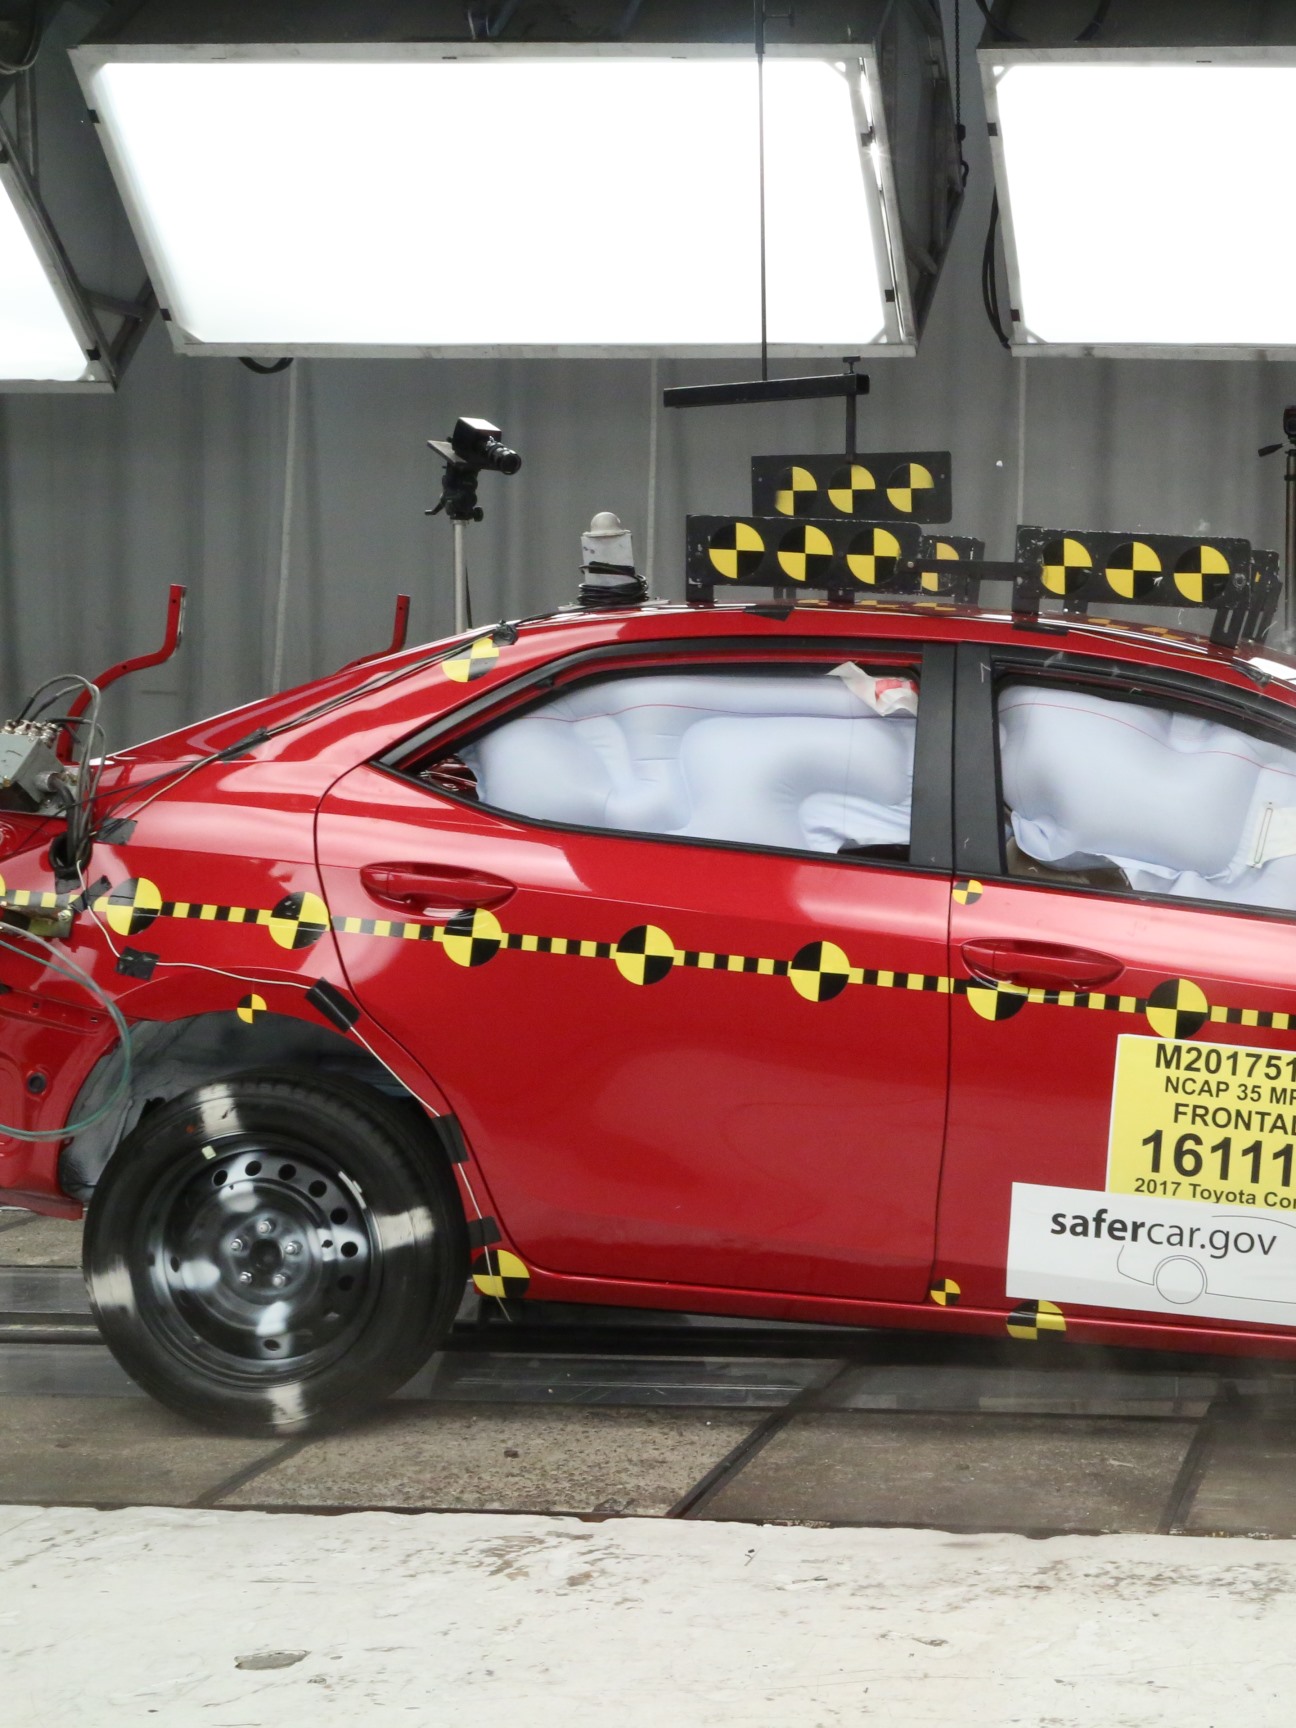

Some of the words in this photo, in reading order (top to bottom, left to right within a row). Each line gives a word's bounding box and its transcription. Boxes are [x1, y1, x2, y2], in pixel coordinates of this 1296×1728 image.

[1164, 1076, 1230, 1099] NCAP
[1236, 1082, 1262, 1103] 35
[1134, 1177, 1182, 1197] 2017
[1188, 1183, 1257, 1205] Toyota
[1050, 1208, 1277, 1259] safercar.gov
